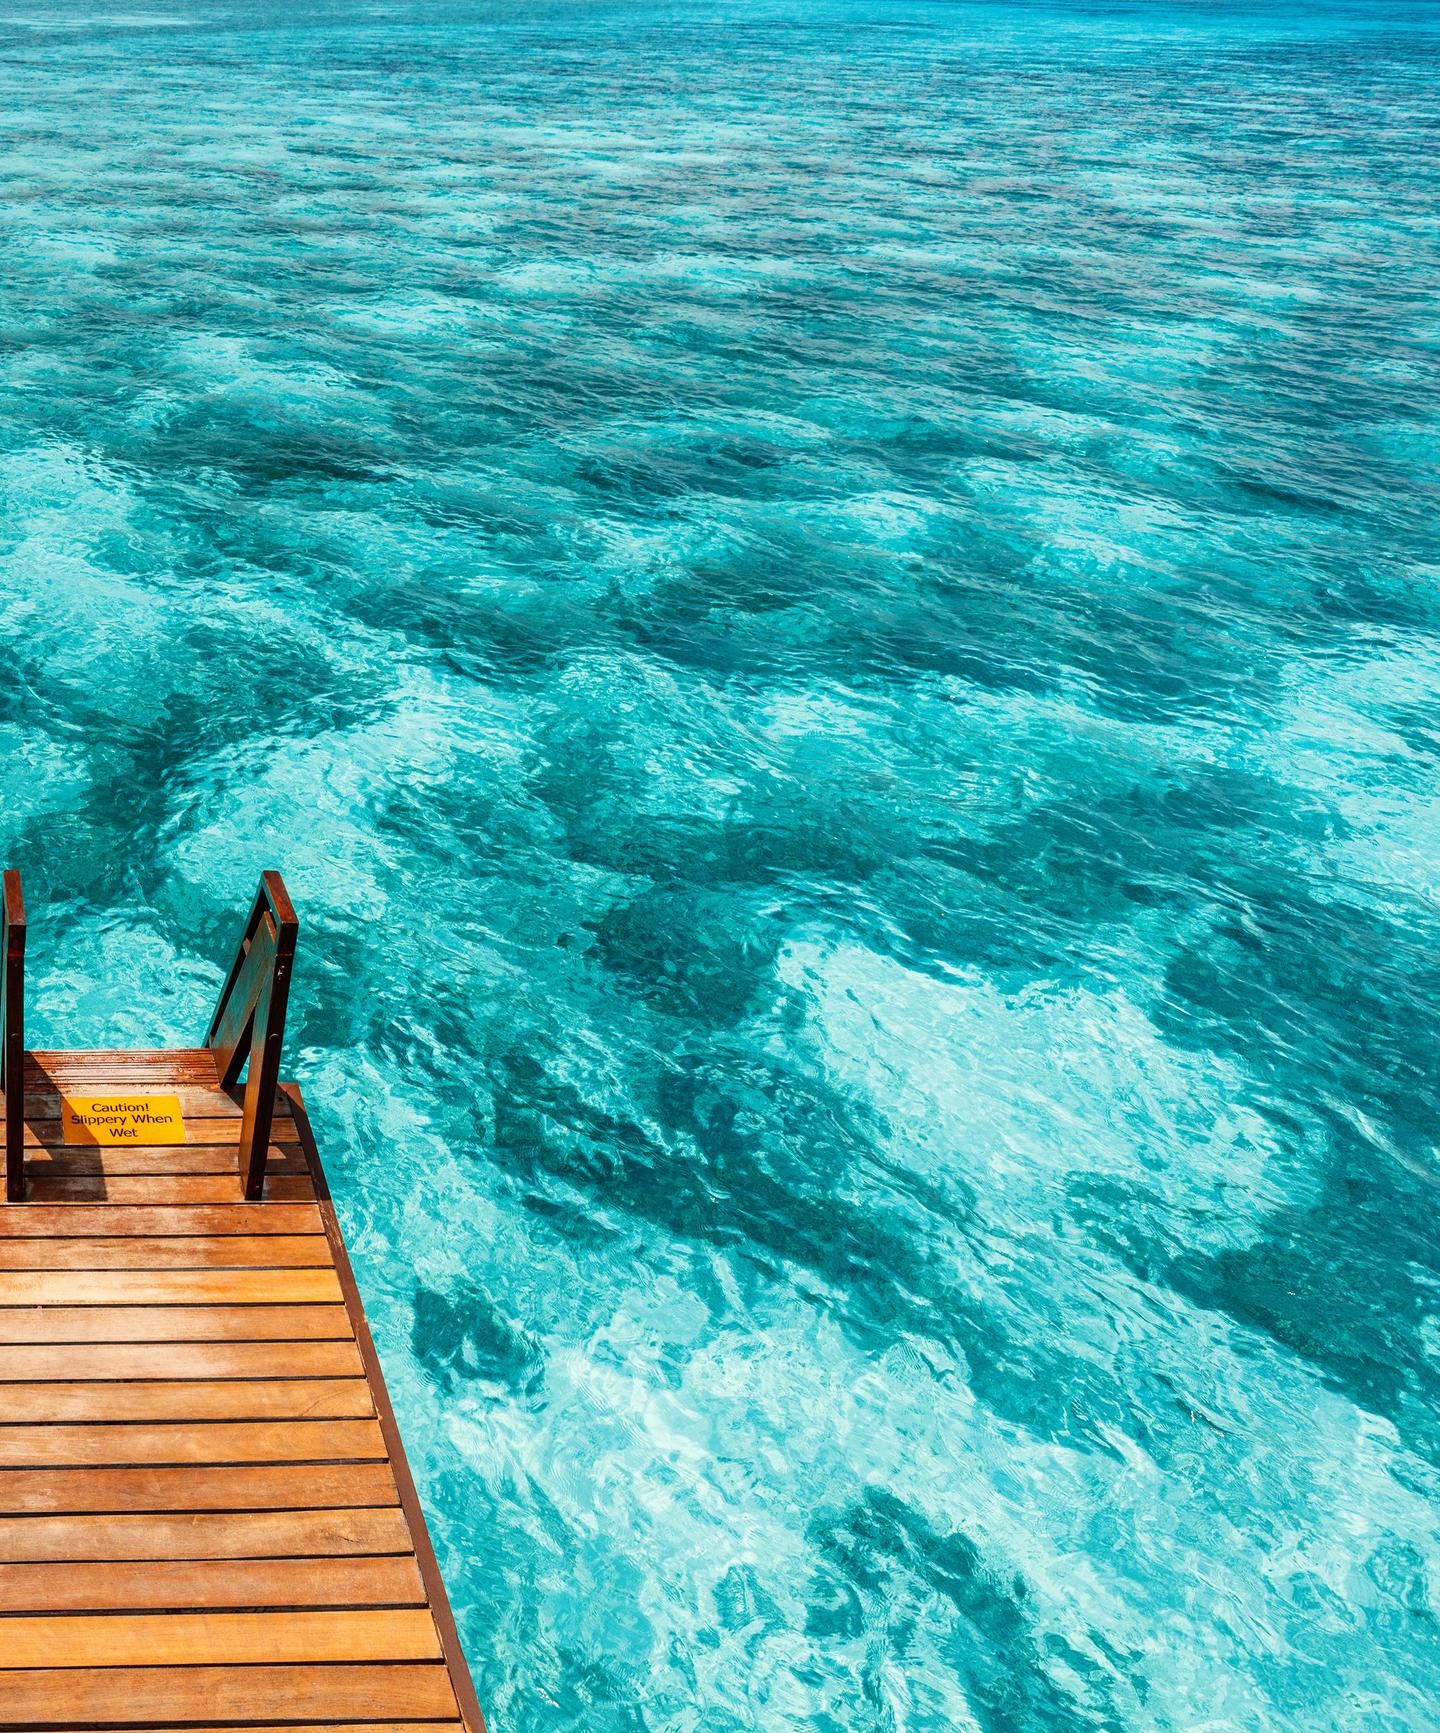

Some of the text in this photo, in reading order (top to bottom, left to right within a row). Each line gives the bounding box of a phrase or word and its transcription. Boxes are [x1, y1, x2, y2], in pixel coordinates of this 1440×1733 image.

[91, 1103, 149, 1113] Caution!
[71, 1114, 173, 1126] Slippery When
[109, 1128, 138, 1138] Wet
